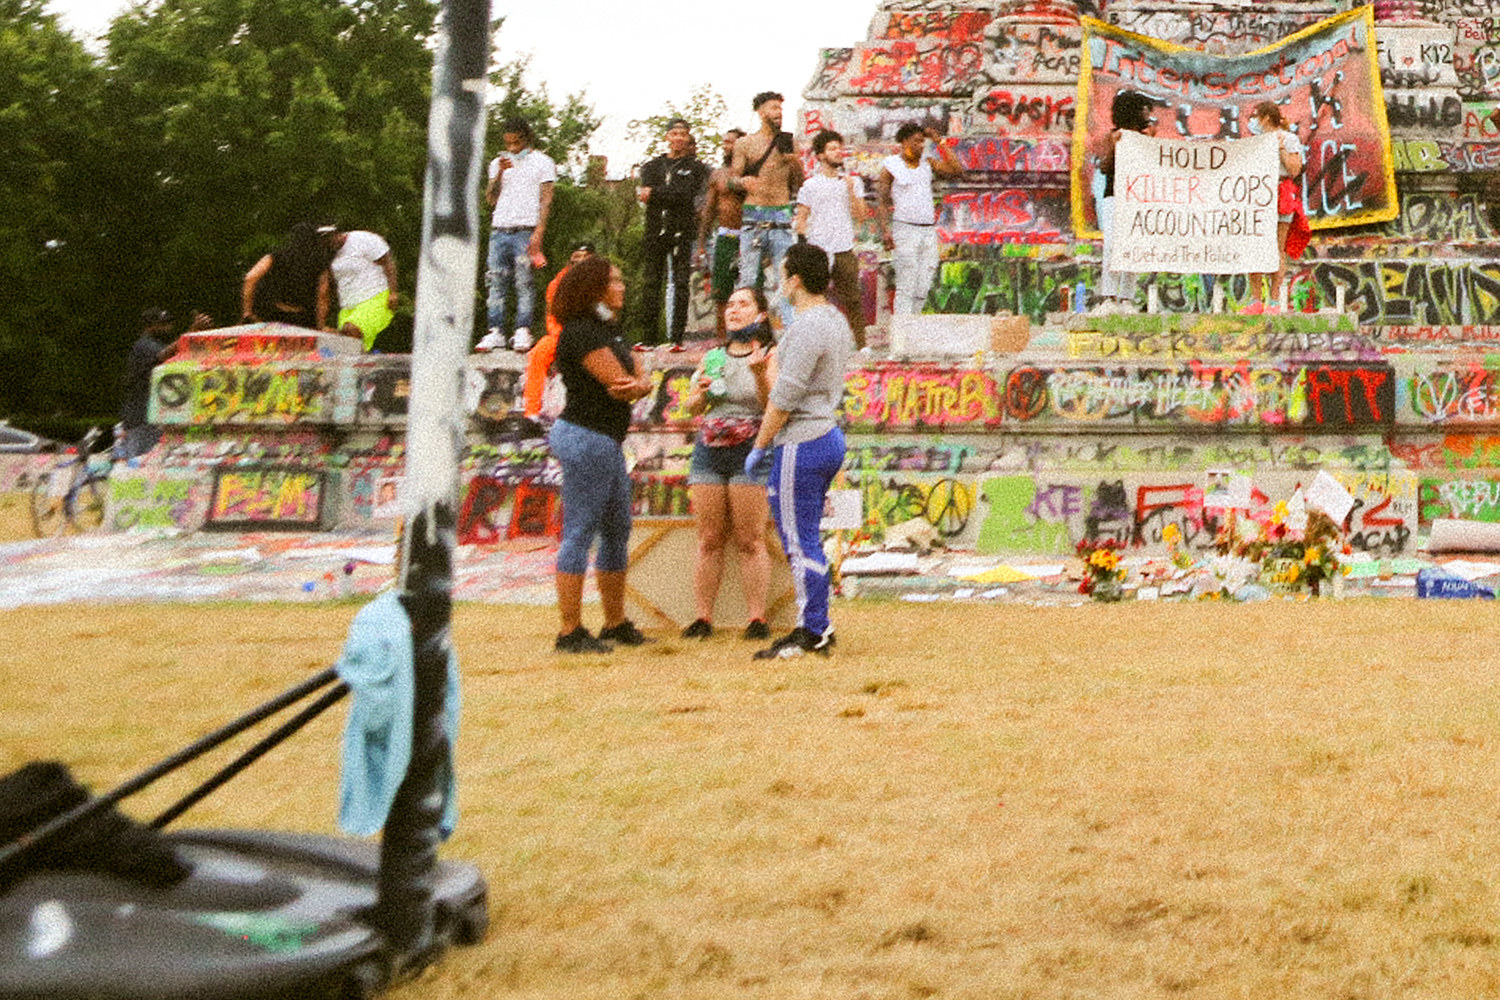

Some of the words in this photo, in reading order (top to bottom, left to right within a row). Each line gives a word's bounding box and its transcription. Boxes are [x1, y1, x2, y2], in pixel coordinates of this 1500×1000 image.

[1094, 24, 1359, 99] Intersectional
[1159, 145, 1227, 170] HOLD
[1125, 174, 1206, 204] KILLER
[1219, 174, 1273, 207] COPS
[1130, 209, 1265, 237] ACCOUNTABLE
